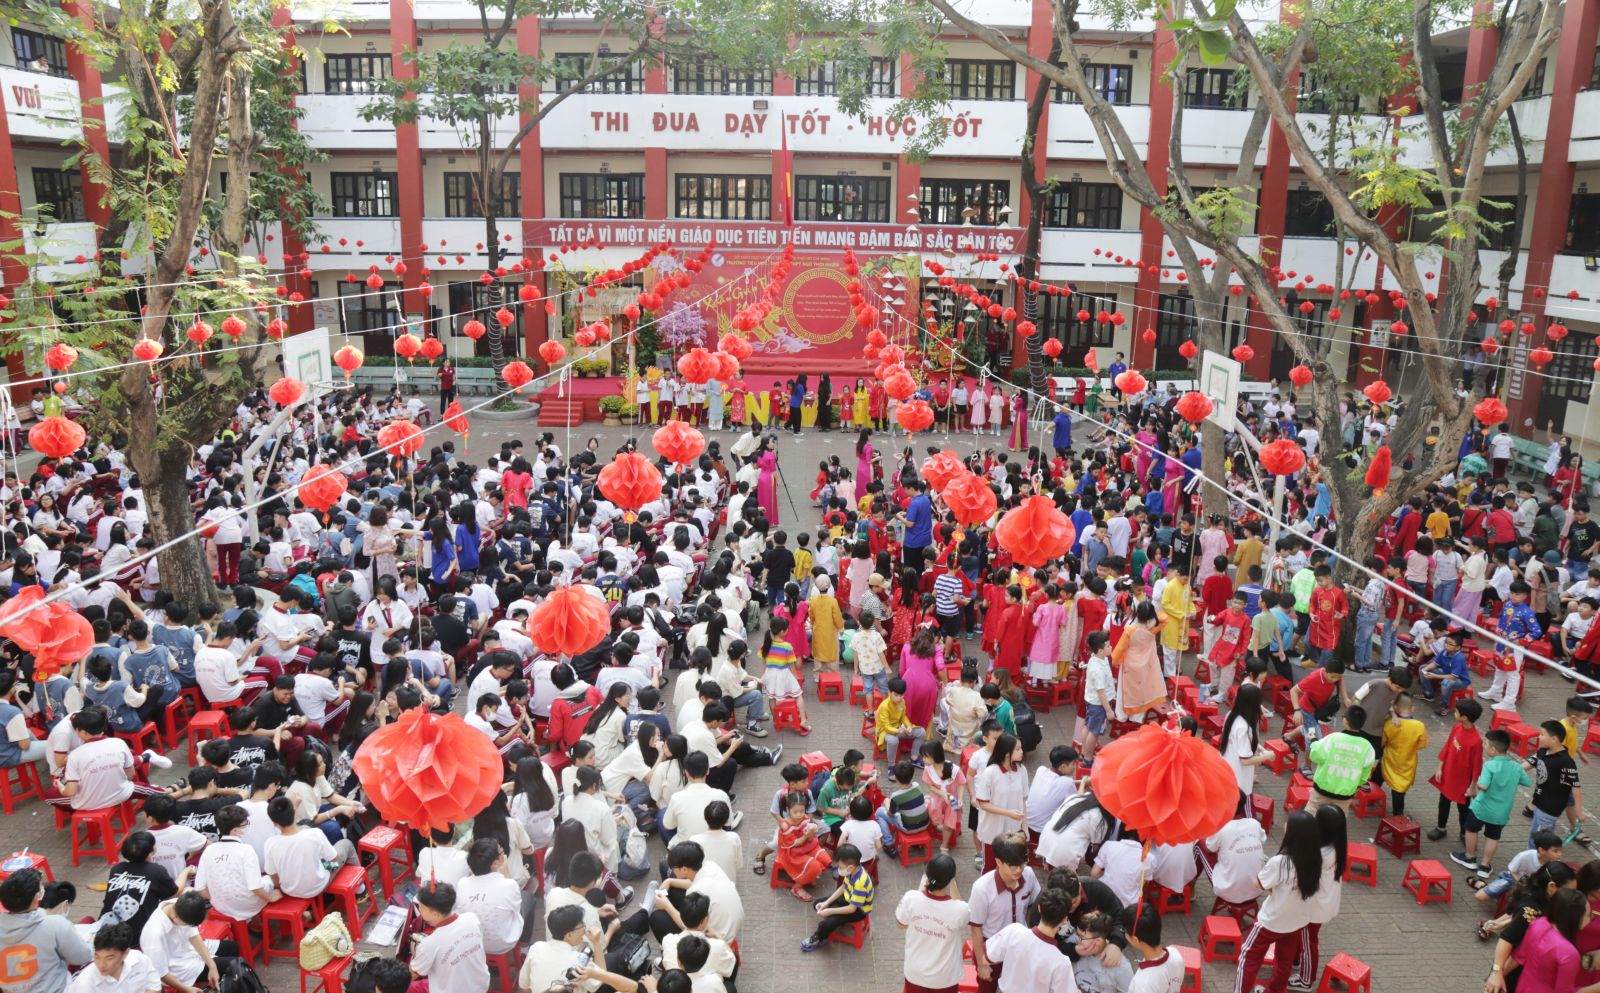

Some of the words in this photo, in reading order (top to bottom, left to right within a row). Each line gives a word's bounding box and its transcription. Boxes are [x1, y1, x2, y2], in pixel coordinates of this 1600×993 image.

[12, 84, 41, 109] vui
[590, 111, 629, 132] THI
[652, 112, 700, 132] ĐUA
[724, 113, 768, 138] DẠY
[786, 107, 831, 135] TỐT
[868, 115, 917, 142] HỌC
[549, 222, 573, 242] TẤT
[576, 223, 595, 242] CẢ
[598, 225, 611, 242] VÌ
[615, 225, 644, 246] MỘT
[680, 226, 711, 243] GIÁO
[715, 229, 743, 247] DỤC
[746, 227, 777, 245] TIÊN
[780, 226, 811, 246] TIẾN
[814, 230, 856, 246] MANG
[859, 229, 890, 250] ĐẬM
[926, 228, 953, 249] SẮC
